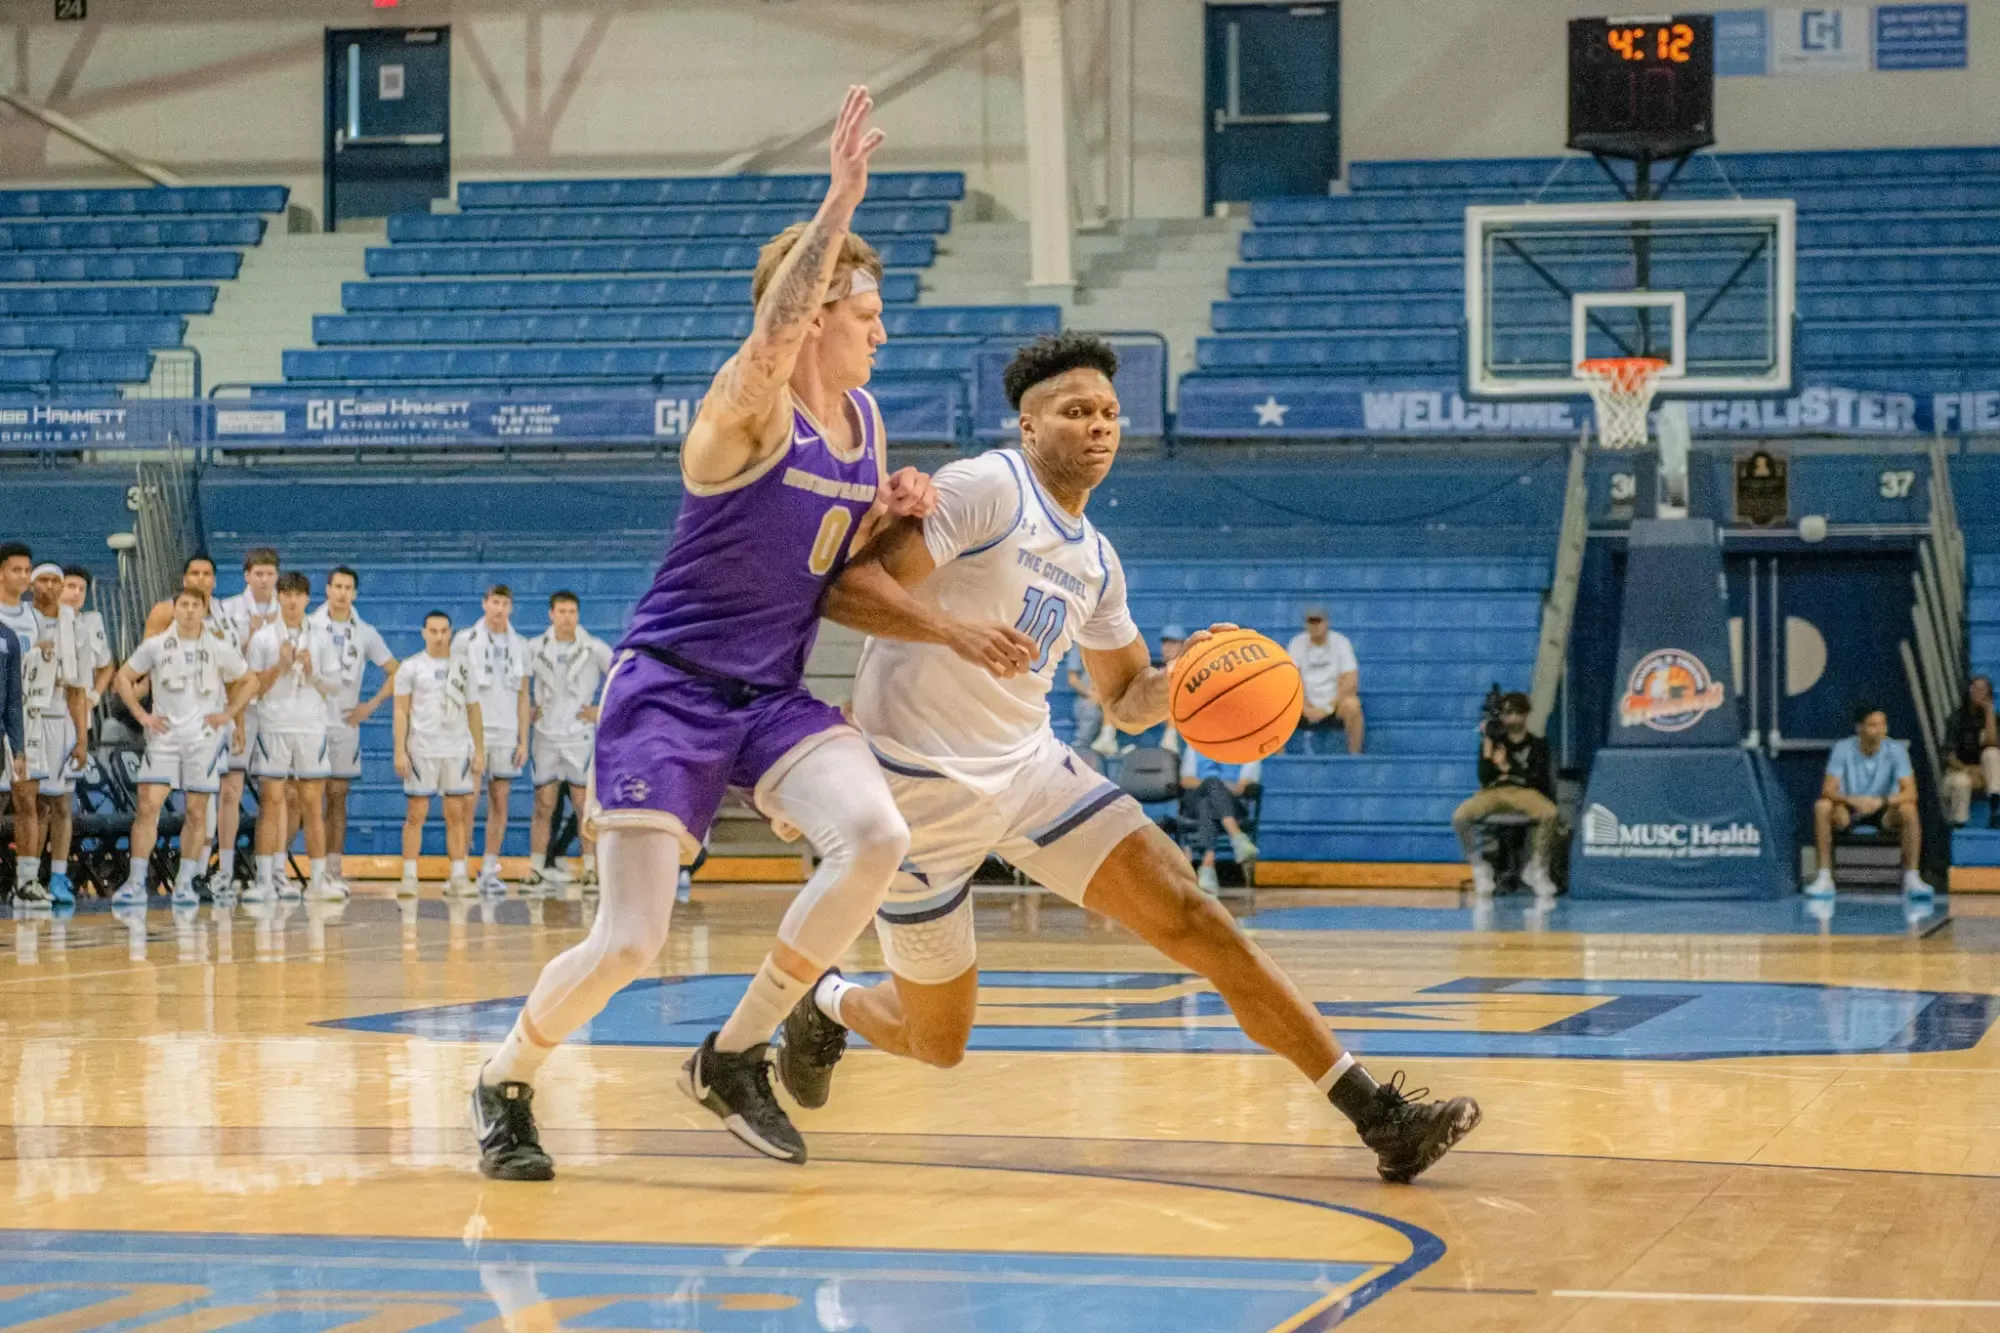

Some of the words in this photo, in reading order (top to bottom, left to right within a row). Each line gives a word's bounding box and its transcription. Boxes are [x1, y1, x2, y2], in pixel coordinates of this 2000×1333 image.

[1607, 23, 1695, 63] 4:12
[33, 404, 127, 425] HAMMETT
[1362, 391, 1575, 431] WELCOME
[95, 430, 126, 441] LAW
[1880, 471, 1915, 498] 37
[808, 506, 852, 576] 0
[1017, 547, 1043, 573] THE
[1042, 561, 1087, 600] CITADEL
[1014, 585, 1067, 673] 10
[1184, 643, 1269, 694] Wilson
[1619, 823, 1689, 846] MUSC
[1691, 821, 1761, 845] Health
